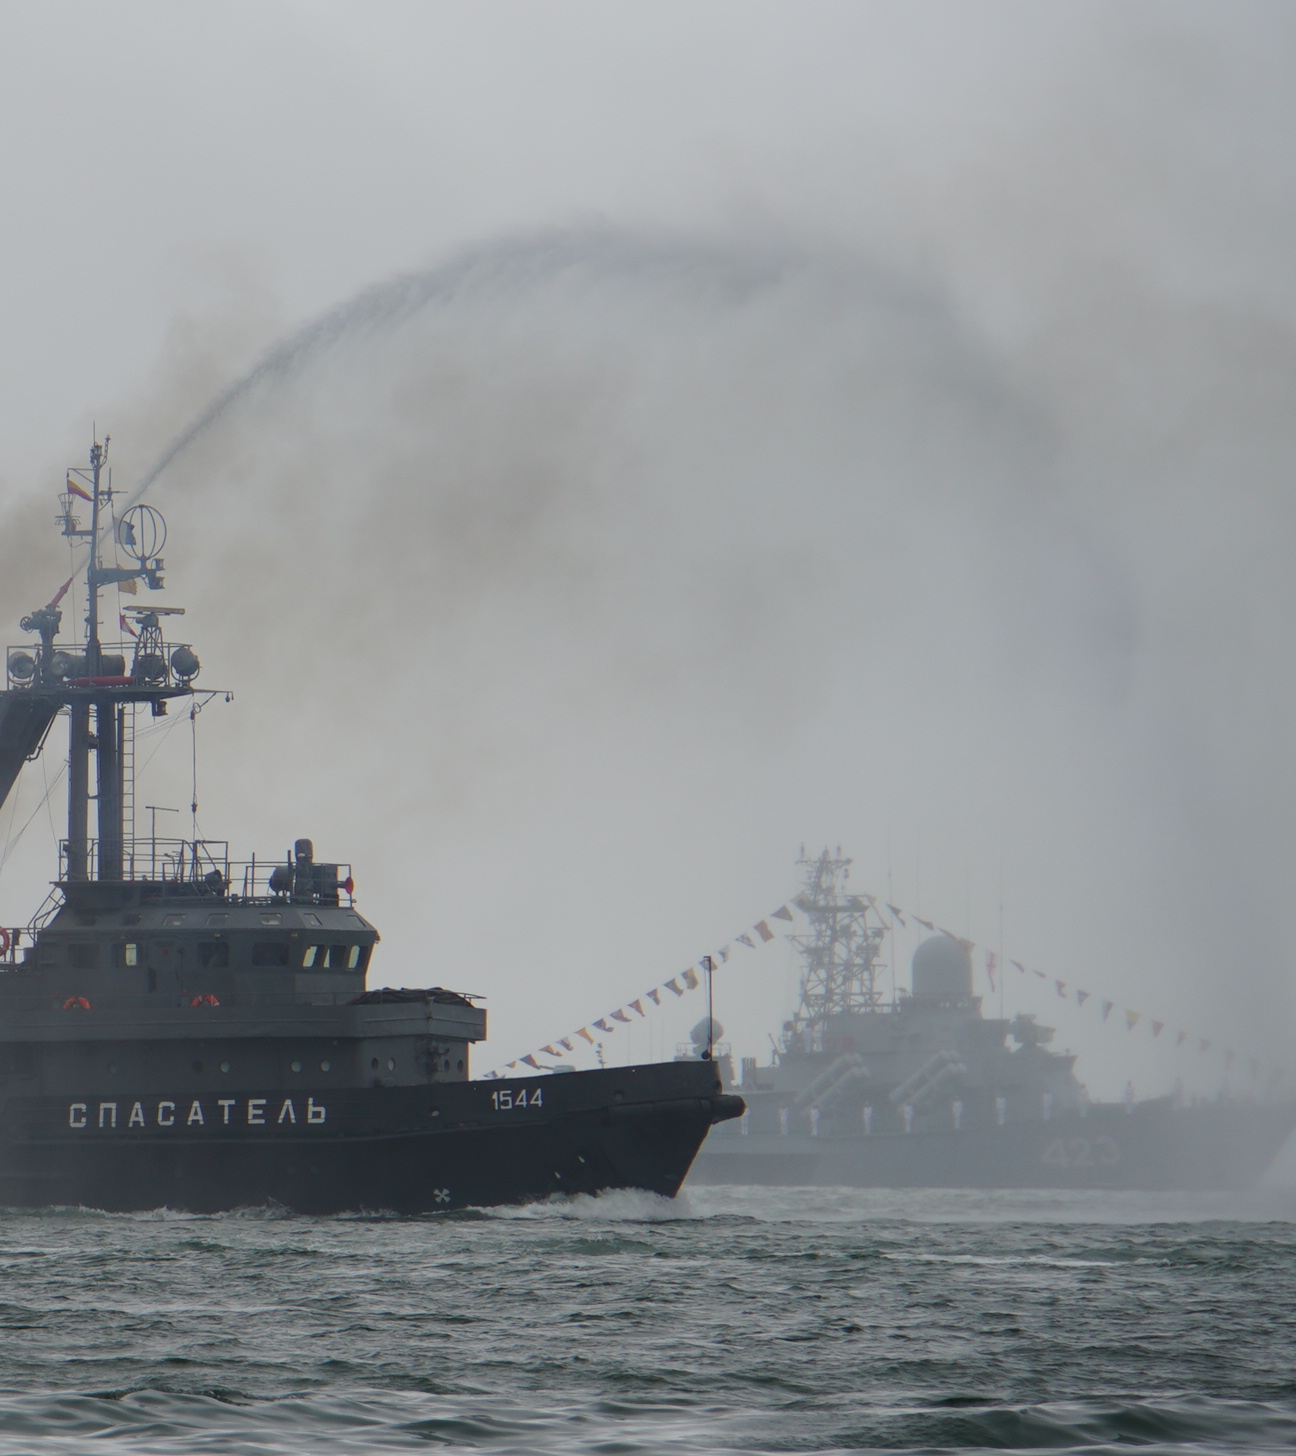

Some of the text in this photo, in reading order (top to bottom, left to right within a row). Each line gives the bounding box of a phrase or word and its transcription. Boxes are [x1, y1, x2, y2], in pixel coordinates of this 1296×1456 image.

[70, 1097, 325, 1128] СПАСАТЕЛЬ
[492, 1088, 543, 1110] 1544
[1042, 1136, 1121, 1167] 423
